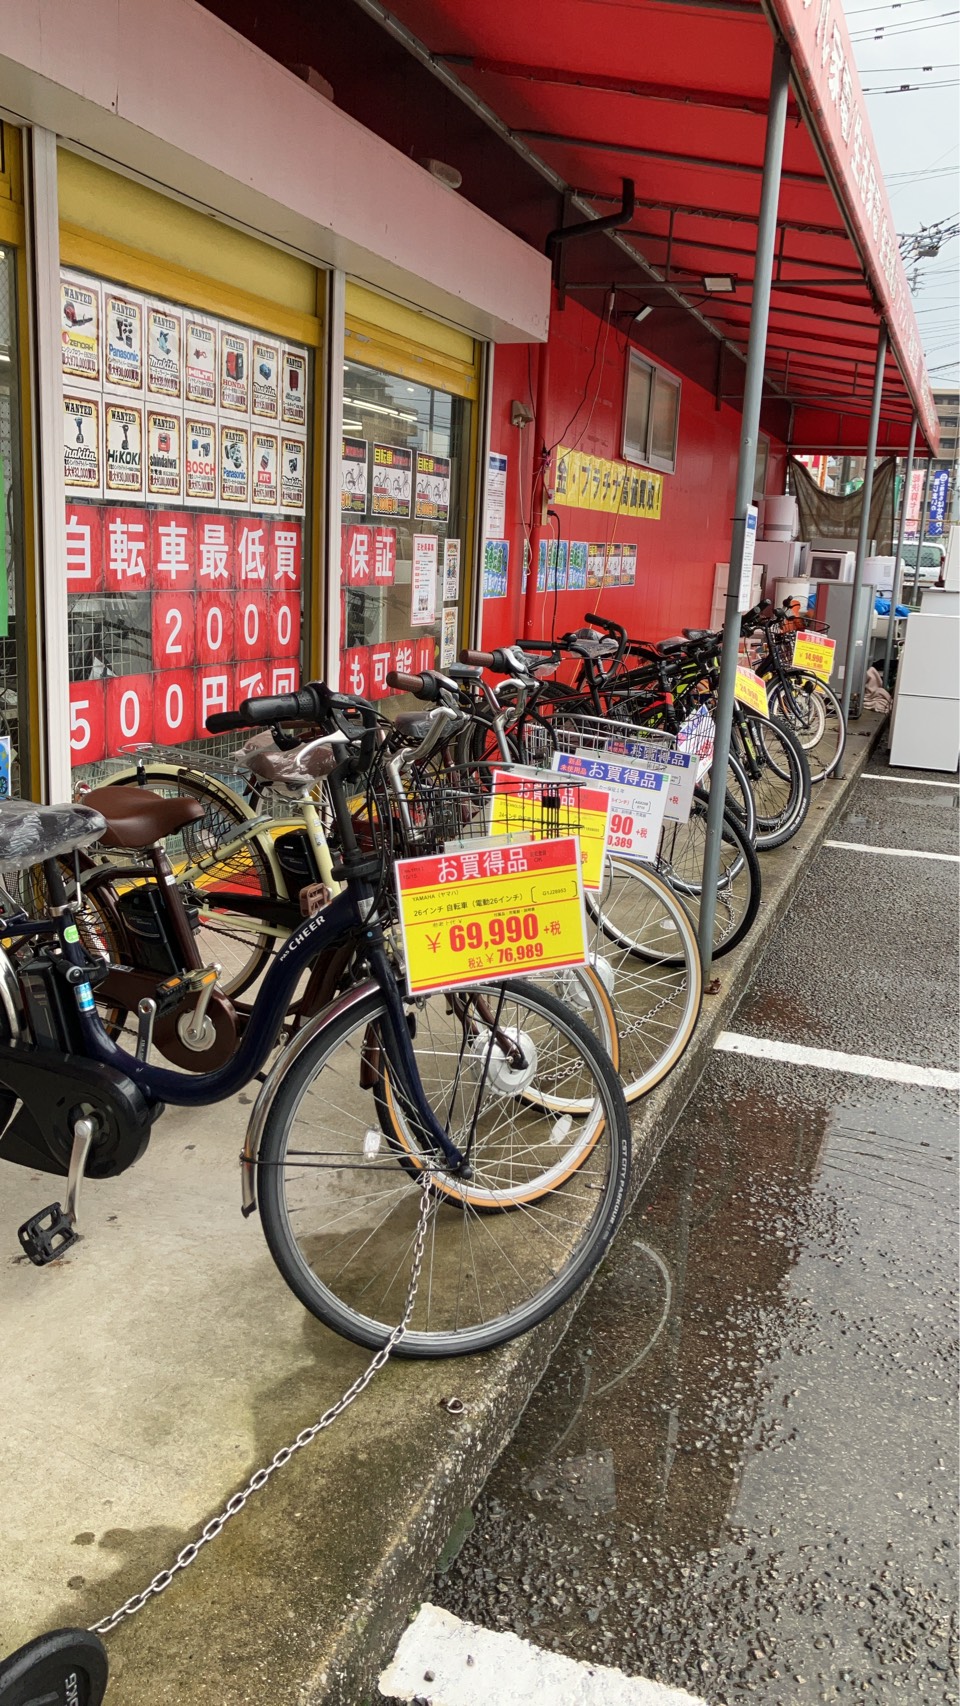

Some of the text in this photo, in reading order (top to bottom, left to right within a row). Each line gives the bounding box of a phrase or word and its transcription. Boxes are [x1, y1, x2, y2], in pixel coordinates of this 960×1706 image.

[64, 286, 92, 305] WANTED
[111, 301, 137, 318] WANTED
[152, 315, 176, 330] WANTED
[191, 327, 211, 341] WANTED
[225, 338, 244, 352] WANTED
[109, 344, 139, 363] Panasonic
[257, 348, 274, 361] WANTED
[149, 355, 178, 373] makita
[287, 357, 302, 369] WANTED
[188, 368, 213, 381] HILTI
[223, 379, 245, 391] HONDA
[64, 402, 93, 416] WANTED
[111, 410, 137, 423] WANTED
[152, 417, 176, 430] WANTED
[191, 425, 211, 437] WANTED
[225, 432, 244, 443] WANTED
[257, 438, 274, 449] WANTED
[64, 445, 96, 462] makita
[285, 443, 302, 453] WANTED
[108, 449, 140, 466] HiKOKI
[150, 454, 177, 469] shindaiwa
[375, 448, 393, 465] 自転車
[186, 461, 216, 476] BOSCH
[418, 457, 434, 472] 自転車
[223, 466, 245, 479] Panasonic
[66, 515, 297, 581] 自転車最低買
[350, 533, 393, 578] 保証
[165, 603, 292, 654] 2000
[568, 757, 582, 766] 新品
[560, 764, 587, 776] 未使用品
[588, 762, 657, 789] お買得品
[610, 813, 634, 836] 90
[636, 827, 648, 838] +税
[437, 847, 529, 884] お買得品
[414, 904, 443, 917] 26インチ
[280, 915, 326, 962] PAS CHEER
[425, 913, 562, 953] ¥ 69,990 +税
[468, 957, 484, 969] 税込
[497, 942, 544, 964] 76,989
[620, 1158, 628, 1178] CITY
[609, 1181, 625, 1226] PARKOUR
